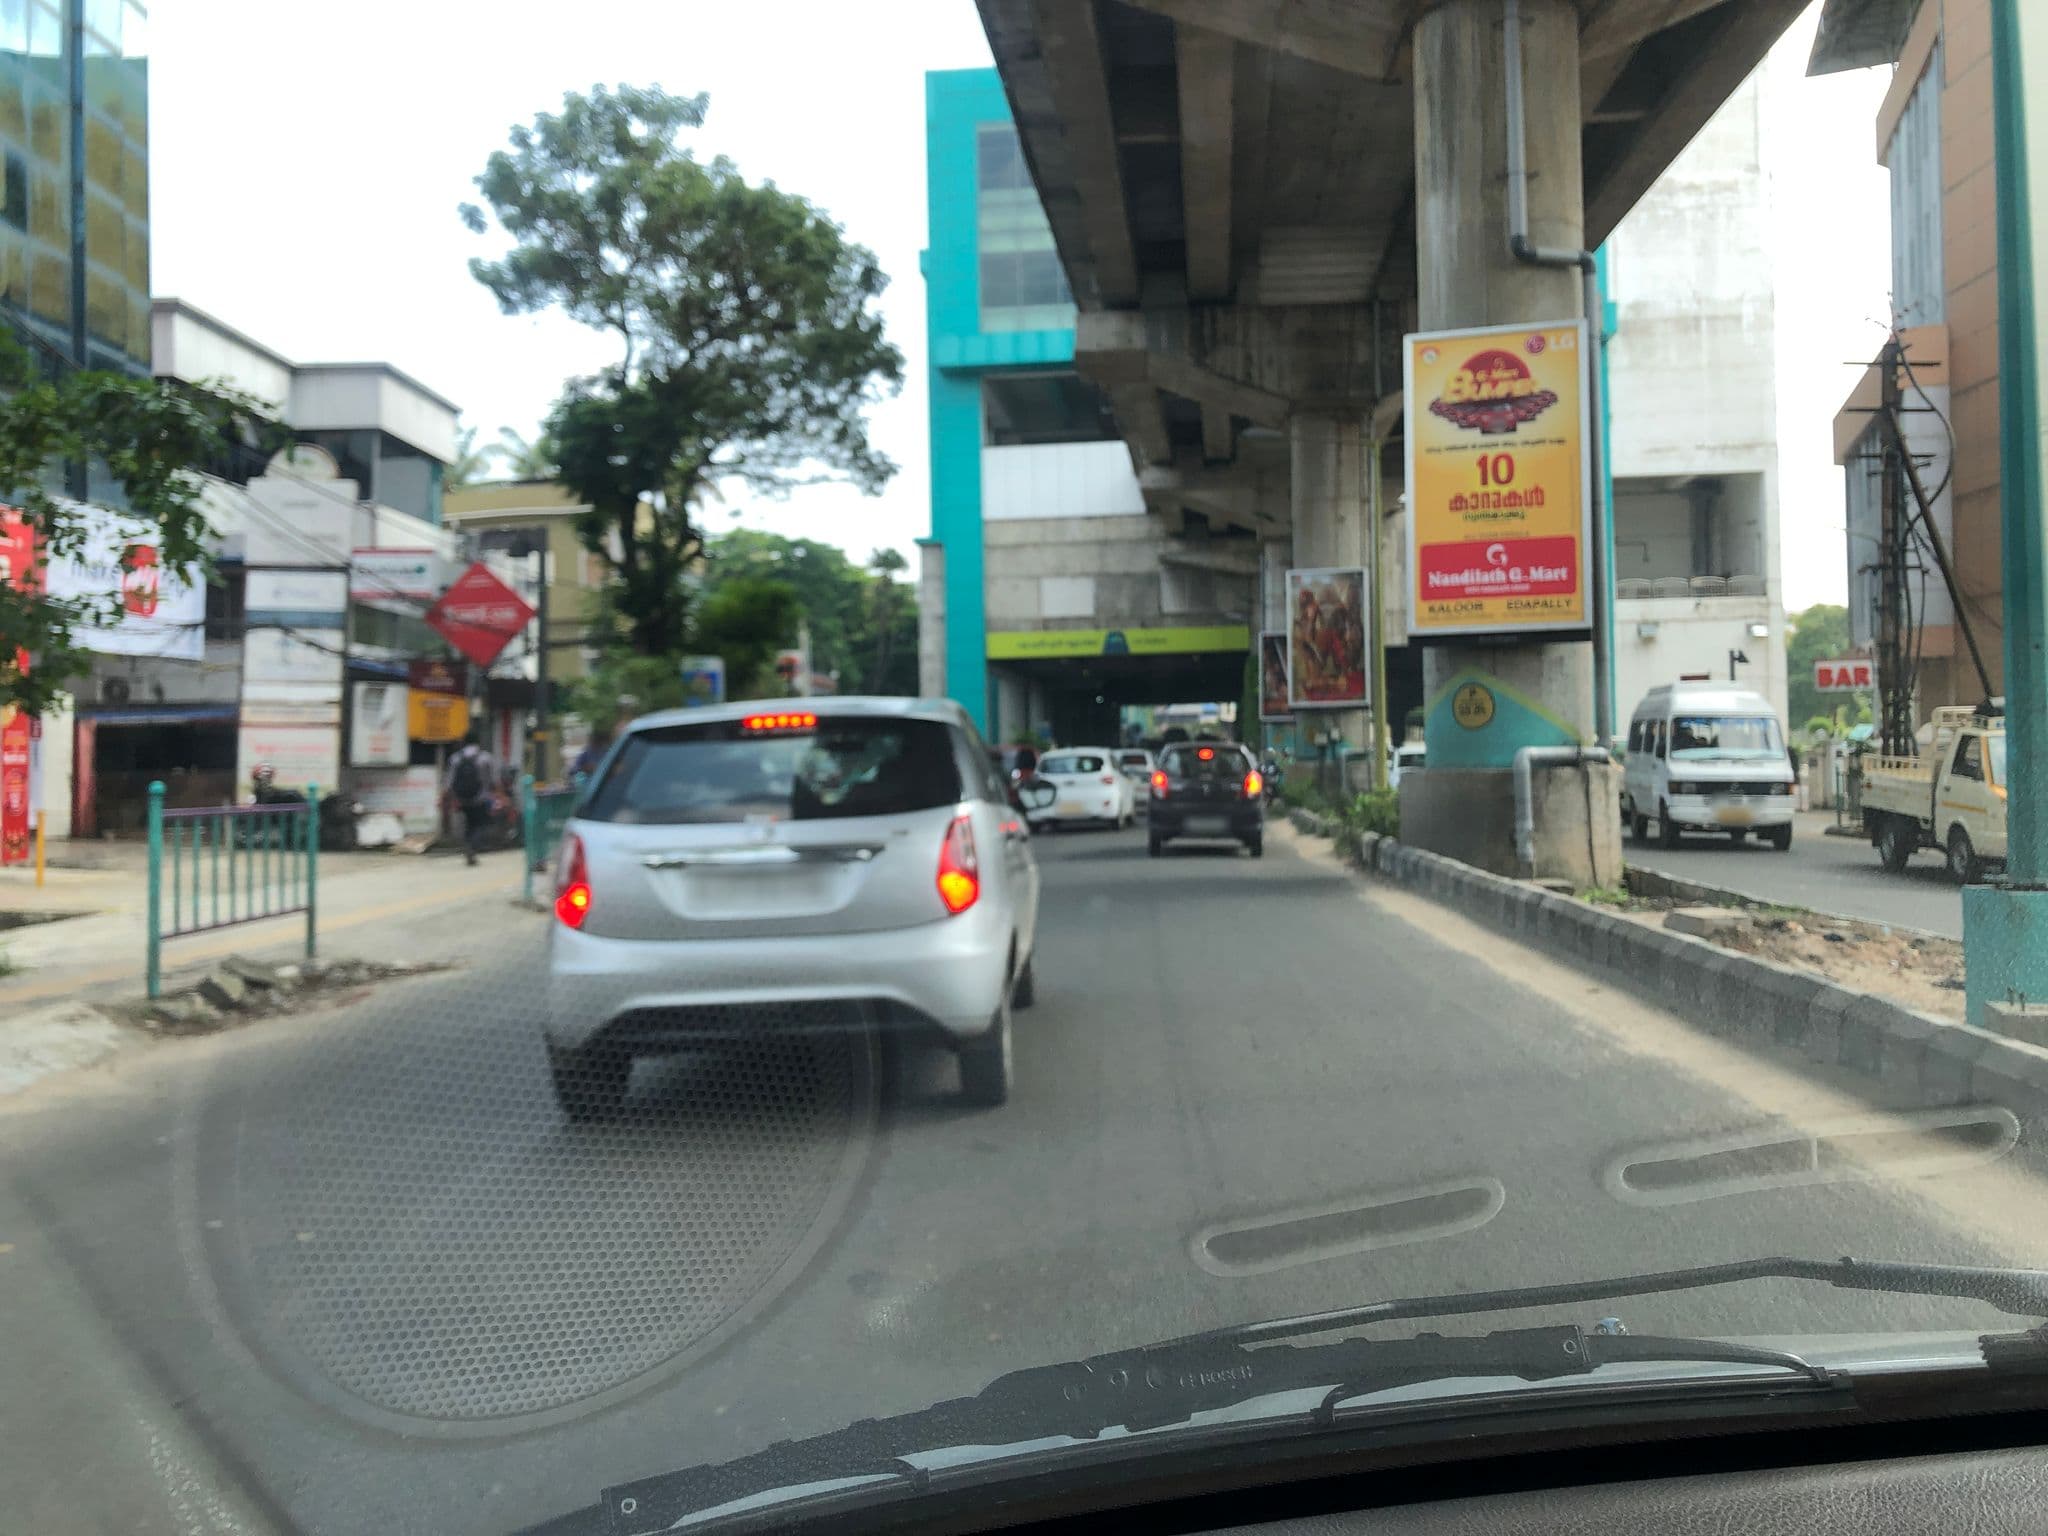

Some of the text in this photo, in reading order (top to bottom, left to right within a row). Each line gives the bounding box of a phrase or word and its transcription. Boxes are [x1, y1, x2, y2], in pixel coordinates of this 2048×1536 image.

[1551, 334, 1575, 349] LG
[1476, 453, 1515, 486] 10
[1428, 568, 1506, 588] Nandilath
[1818, 666, 1870, 688] BAR
